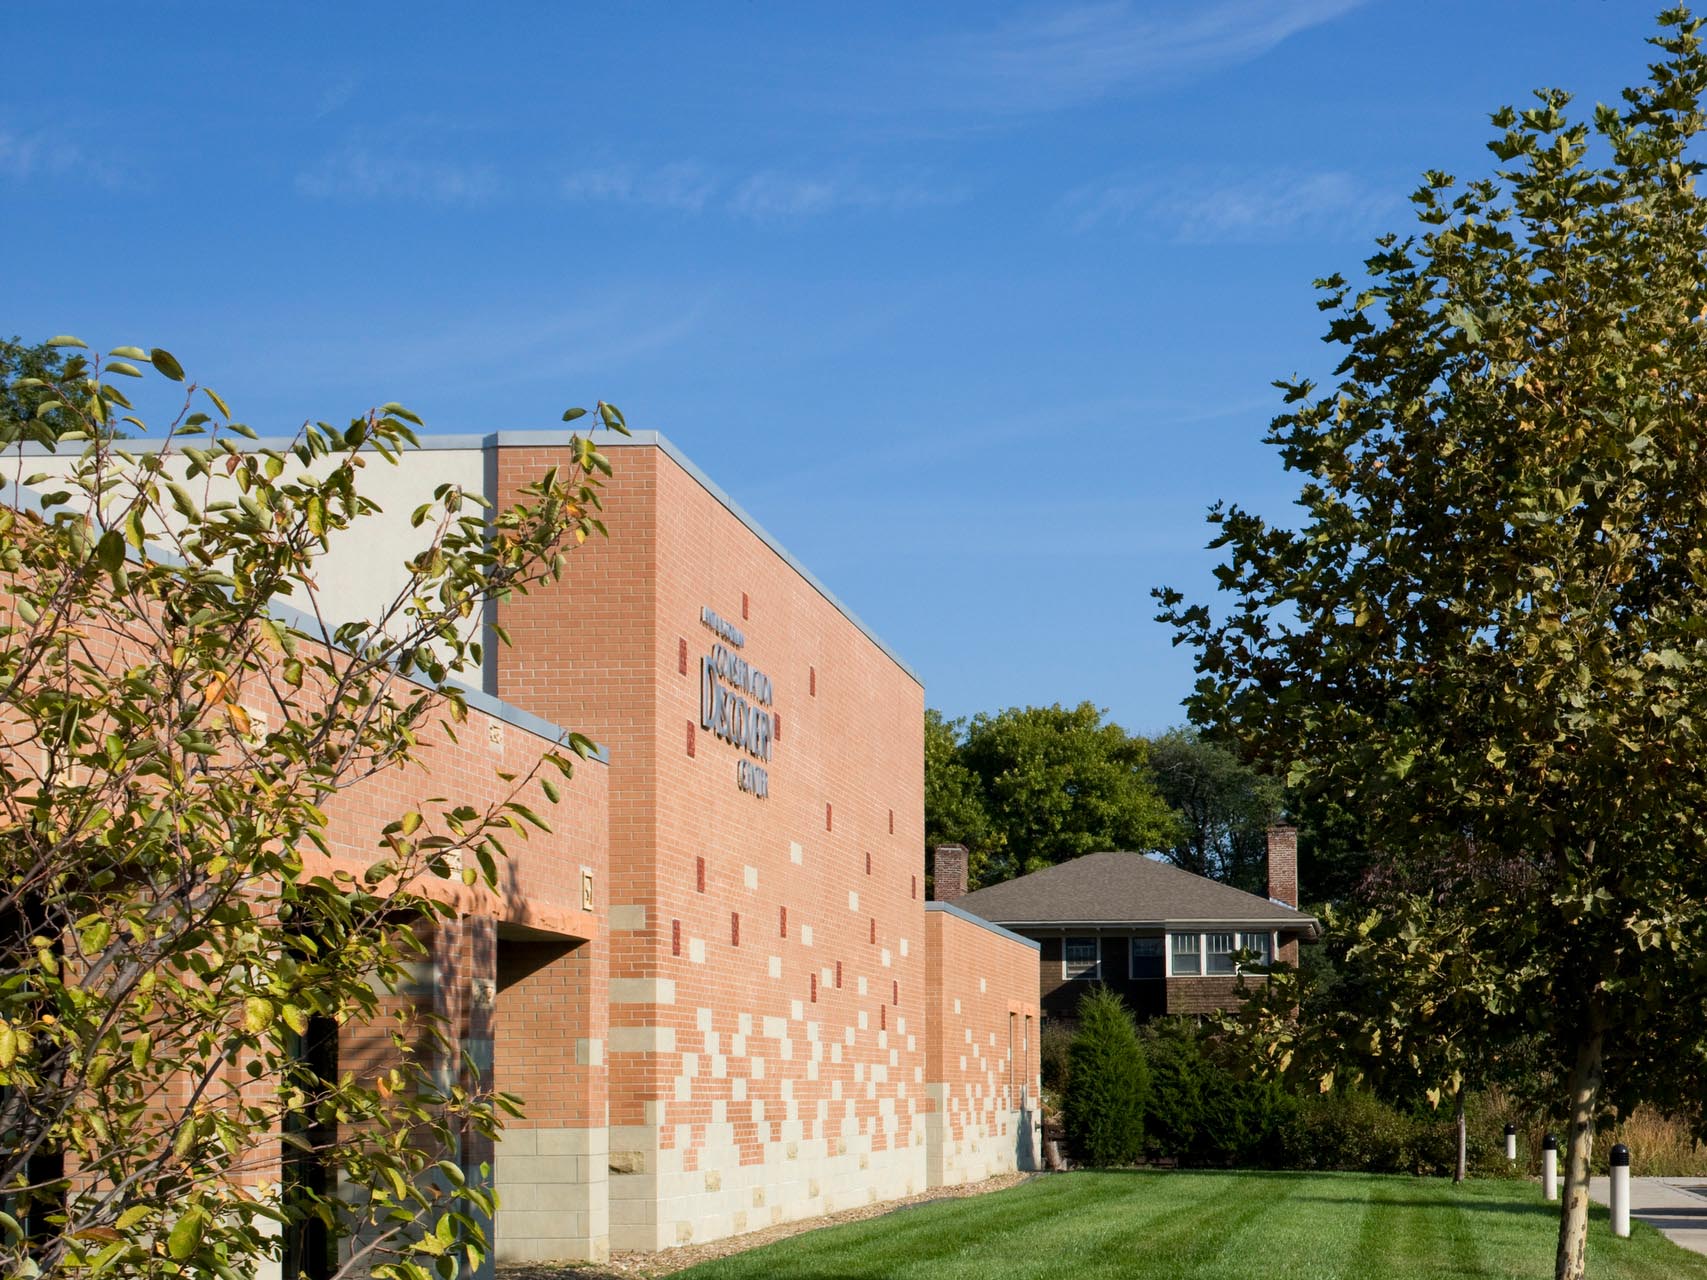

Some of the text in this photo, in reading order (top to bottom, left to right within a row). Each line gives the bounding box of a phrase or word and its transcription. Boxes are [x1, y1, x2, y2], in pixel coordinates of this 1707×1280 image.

[713, 643, 772, 706] CONSERVATION
[702, 655, 774, 762] DISCOVERY
[738, 759, 768, 798] CENTER
